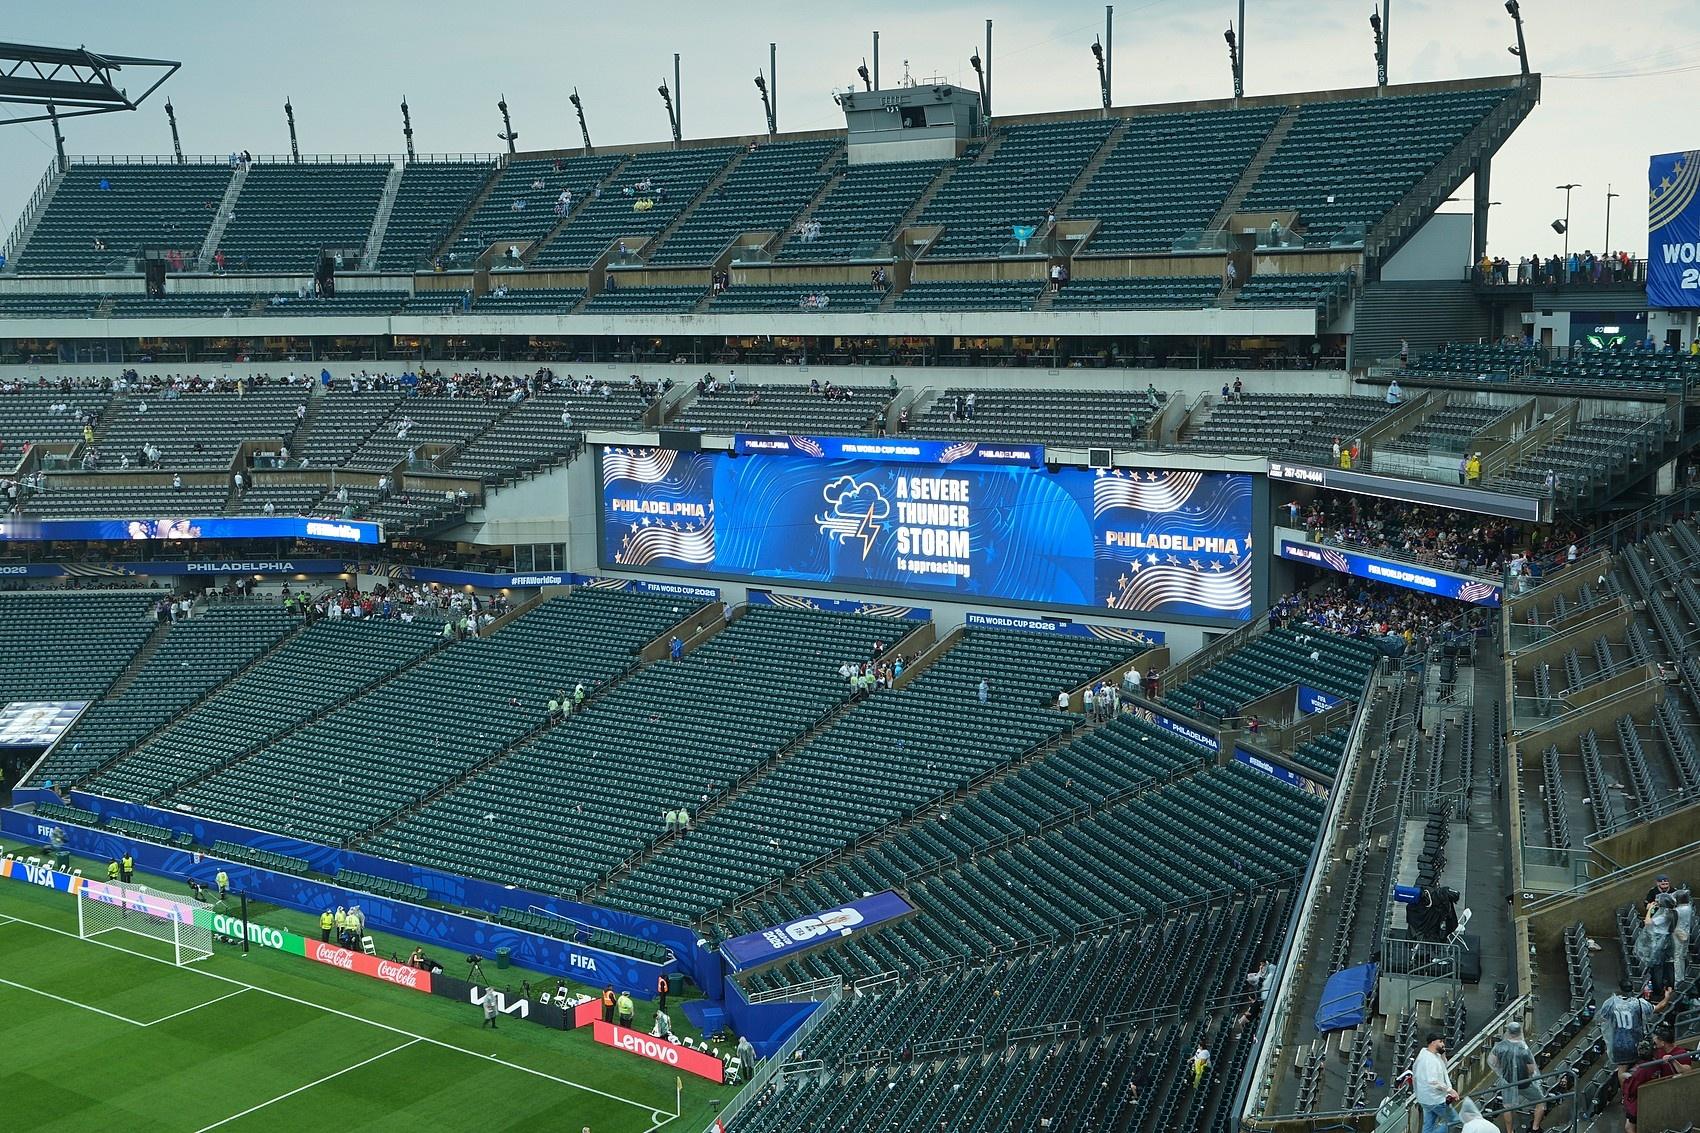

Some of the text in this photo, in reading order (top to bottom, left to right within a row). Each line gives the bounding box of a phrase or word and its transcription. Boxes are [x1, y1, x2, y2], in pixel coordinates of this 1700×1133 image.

[1681, 268, 1700, 289] 2
[745, 440, 790, 450] PHILADELPHIA
[842, 444, 857, 453] FIFA
[856, 445, 881, 454] WORLD
[881, 446, 896, 455] CUP
[978, 450, 1031, 460] PHILADELPHIA
[896, 476, 970, 502] A SEVERE
[612, 498, 706, 517] PHILADELPHIA
[896, 501, 970, 528] THUNDER
[896, 526, 970, 559] STORM
[1105, 530, 1239, 555] PHILADELPHIA
[187, 562, 295, 571] PHILADELPHIA
[907, 559, 971, 578] approaching
[1380, 567, 1402, 580] WORLD
[1402, 571, 1415, 583] CUP
[511, 575, 562, 585] #FIFAWorldCup
[647, 583, 661, 592] FIFA
[660, 584, 682, 593] WORLD
[682, 586, 695, 595] CUP
[694, 588, 716, 597] 2026
[969, 615, 986, 624] FIFA
[985, 617, 1013, 627] WORLD
[1012, 619, 1029, 628] CUP
[1028, 621, 1056, 631] 2026
[1172, 723, 1218, 749] PHILADELPHIA
[23, 864, 55, 889] VISA
[213, 914, 284, 949] aramco
[762, 930, 785, 949] 2026
[570, 953, 597, 972] FIFA
[1613, 1010, 1633, 1030] 10
[613, 1026, 679, 1065] Lenovo
